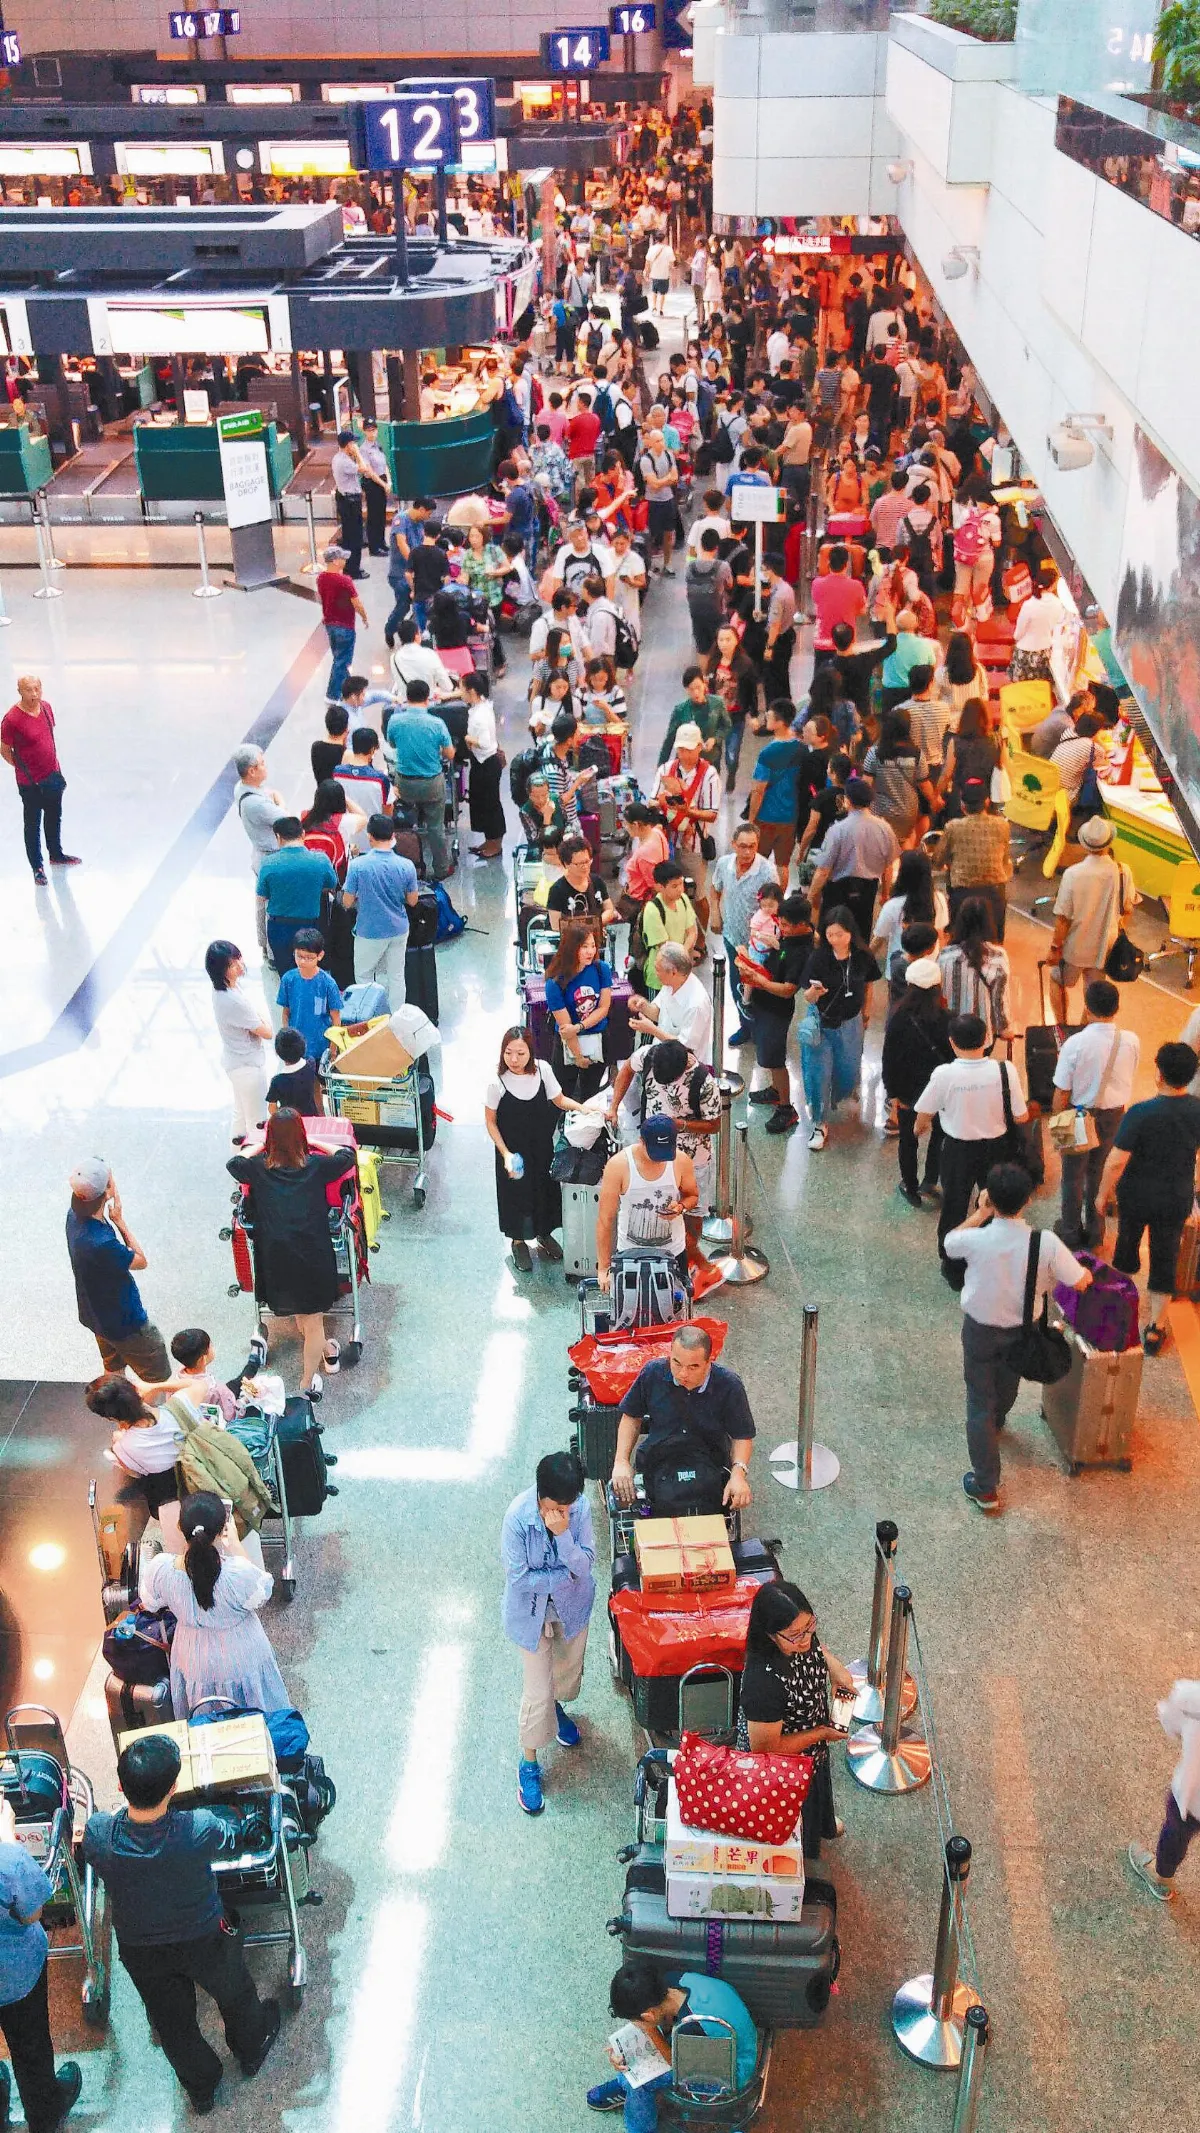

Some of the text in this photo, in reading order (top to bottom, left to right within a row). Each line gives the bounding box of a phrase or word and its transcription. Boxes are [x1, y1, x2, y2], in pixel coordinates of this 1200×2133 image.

[174, 15, 196, 37] 16
[619, 10, 645, 33] 16
[3, 34, 20, 64] 15
[557, 36, 592, 68] 14
[459, 87, 480, 137] 3
[379, 105, 443, 162] 12
[229, 476, 265, 491] BAGGAGE
[237, 486, 258, 497] DROP
[727, 1847, 759, 1865] 芒果
